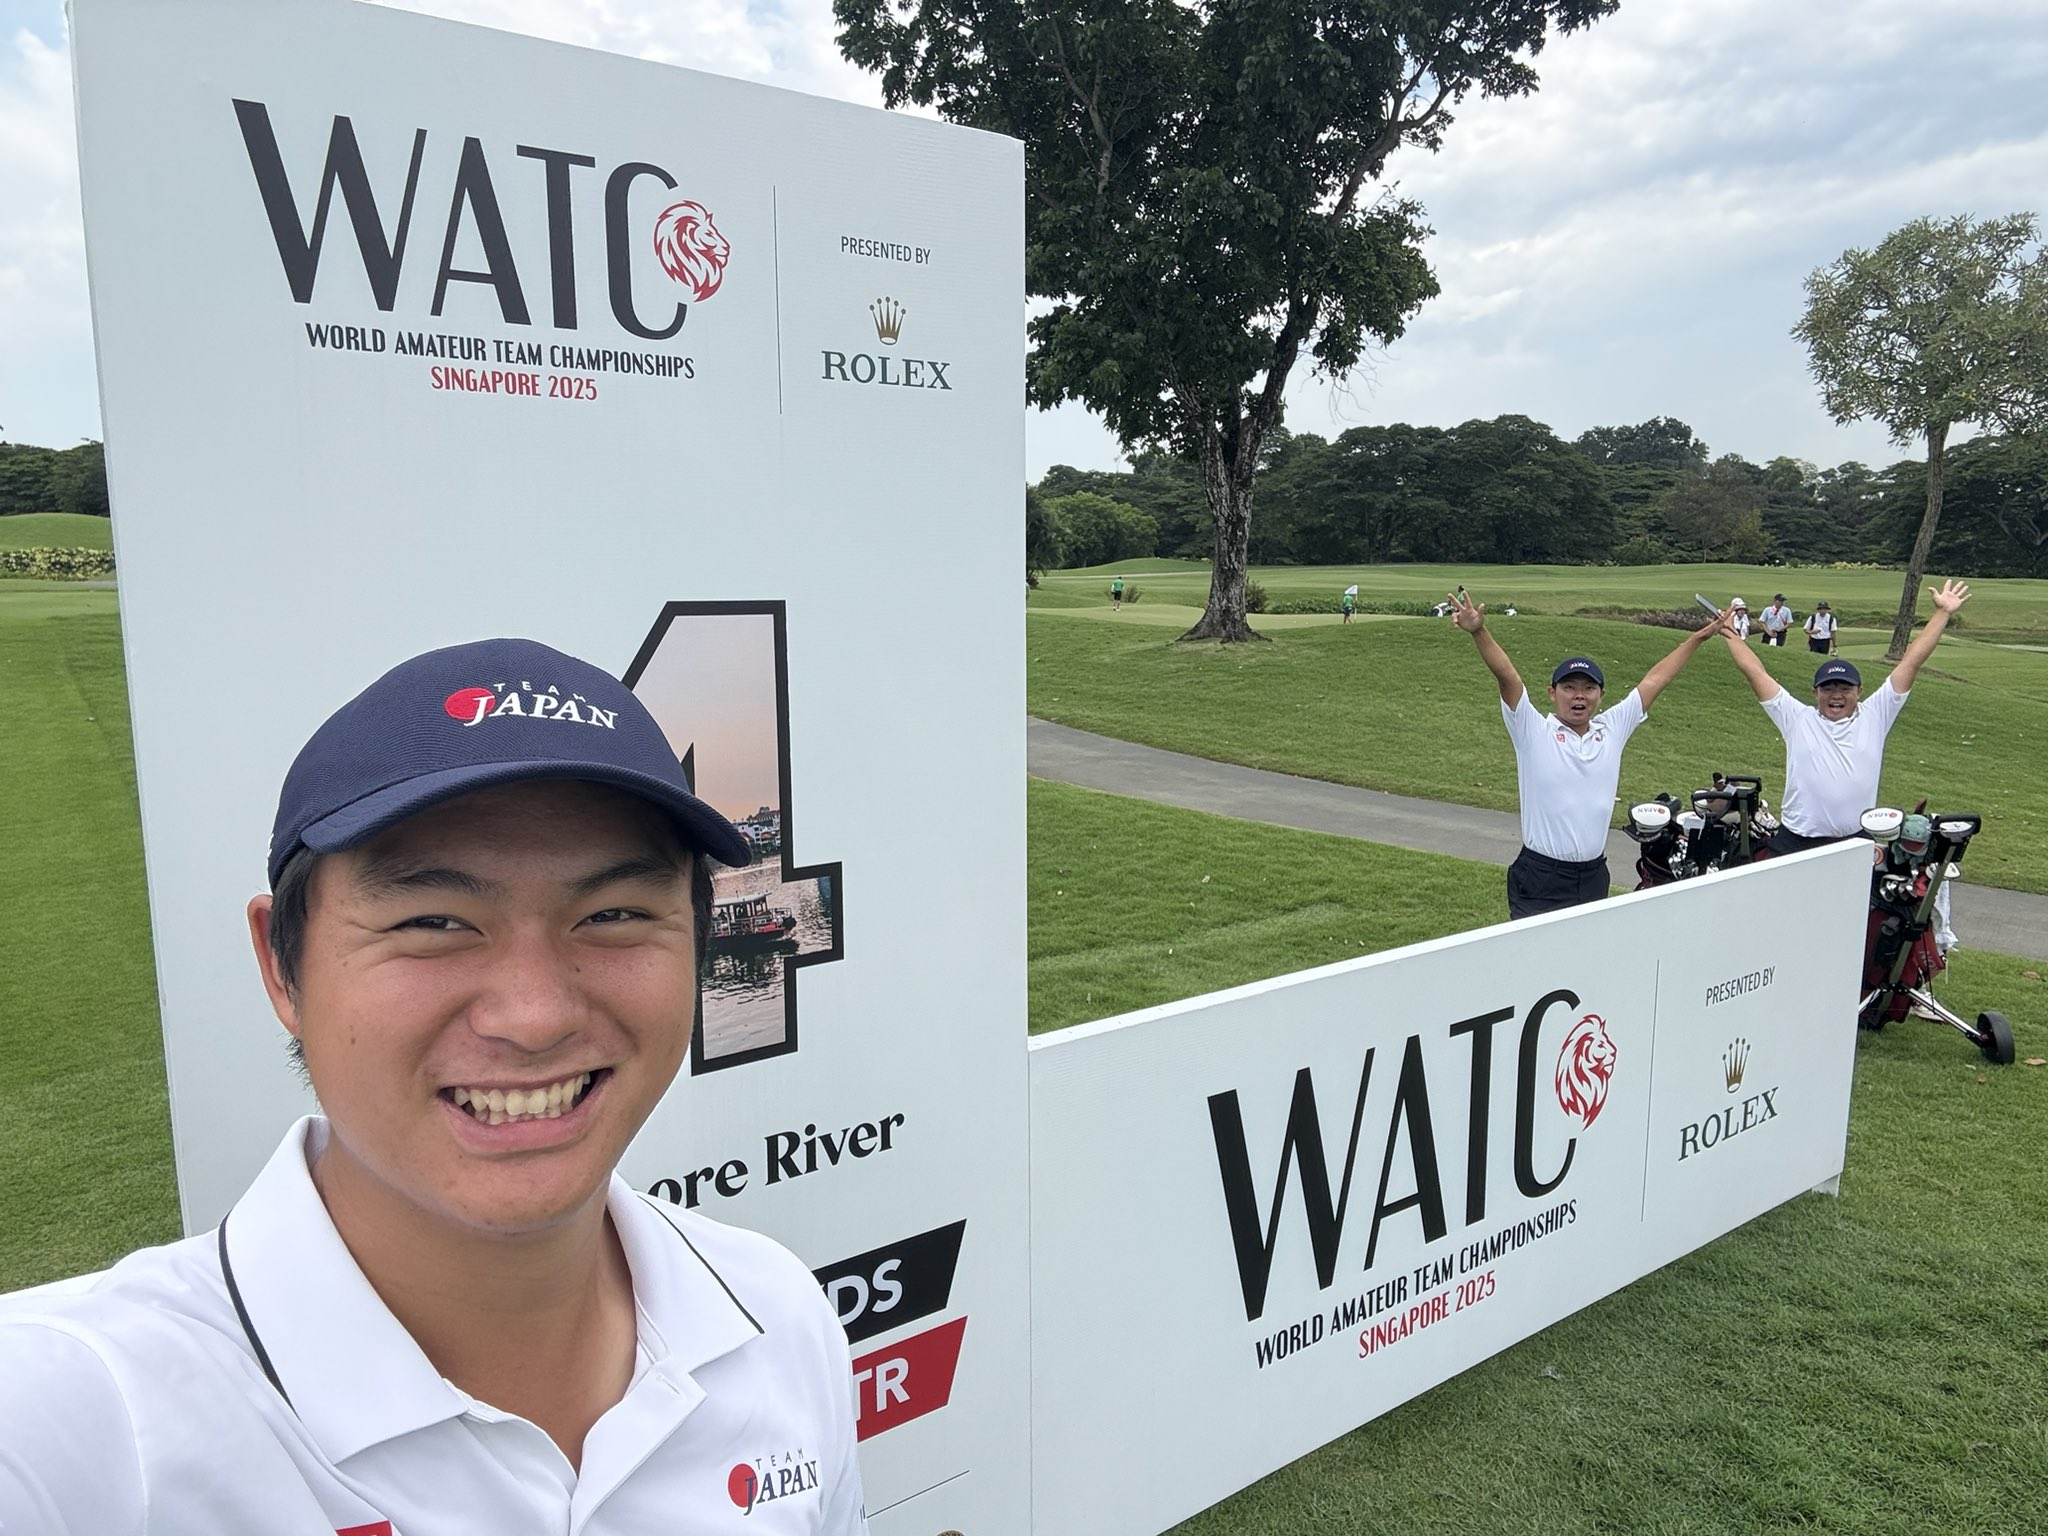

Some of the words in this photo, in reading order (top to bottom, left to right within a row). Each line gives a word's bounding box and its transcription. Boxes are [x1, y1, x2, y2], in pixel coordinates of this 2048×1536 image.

[231, 97, 688, 340] WATC
[841, 235, 912, 262] PRESENTED
[915, 247, 931, 265] BY
[304, 322, 386, 353] WORLD
[394, 331, 487, 362] AMATEUR
[492, 339, 543, 367] TEAM
[549, 344, 696, 380] CHAMPIONSHIPS
[821, 350, 953, 391] ROLEX
[430, 365, 542, 397] SINGAPORE
[547, 375, 598, 401] 2025
[463, 691, 619, 730] JAPAN
[493, 680, 587, 703] TEAM
[621, 599, 845, 1077] 4
[1705, 971, 1761, 1007] PRESENTED
[1762, 965, 1776, 987] BY
[1677, 1086, 1780, 1162] ROLEX
[646, 1159, 749, 1210] ore
[764, 1112, 906, 1187] River
[1206, 988, 1582, 1323] WATC
[822, 1257, 904, 1327] DS
[1255, 1313, 1324, 1370] WORLD
[1329, 1275, 1408, 1336] AMATEUR
[1413, 1253, 1454, 1296] TEAM
[1459, 1198, 1578, 1275] CHAMPIONSHIPS
[1358, 1290, 1451, 1360] SINGAPORE
[1454, 1269, 1496, 1313] 2025
[852, 1356, 911, 1422] TR
[743, 1459, 819, 1517] JAPAN
[754, 1447, 804, 1471] TEAM
